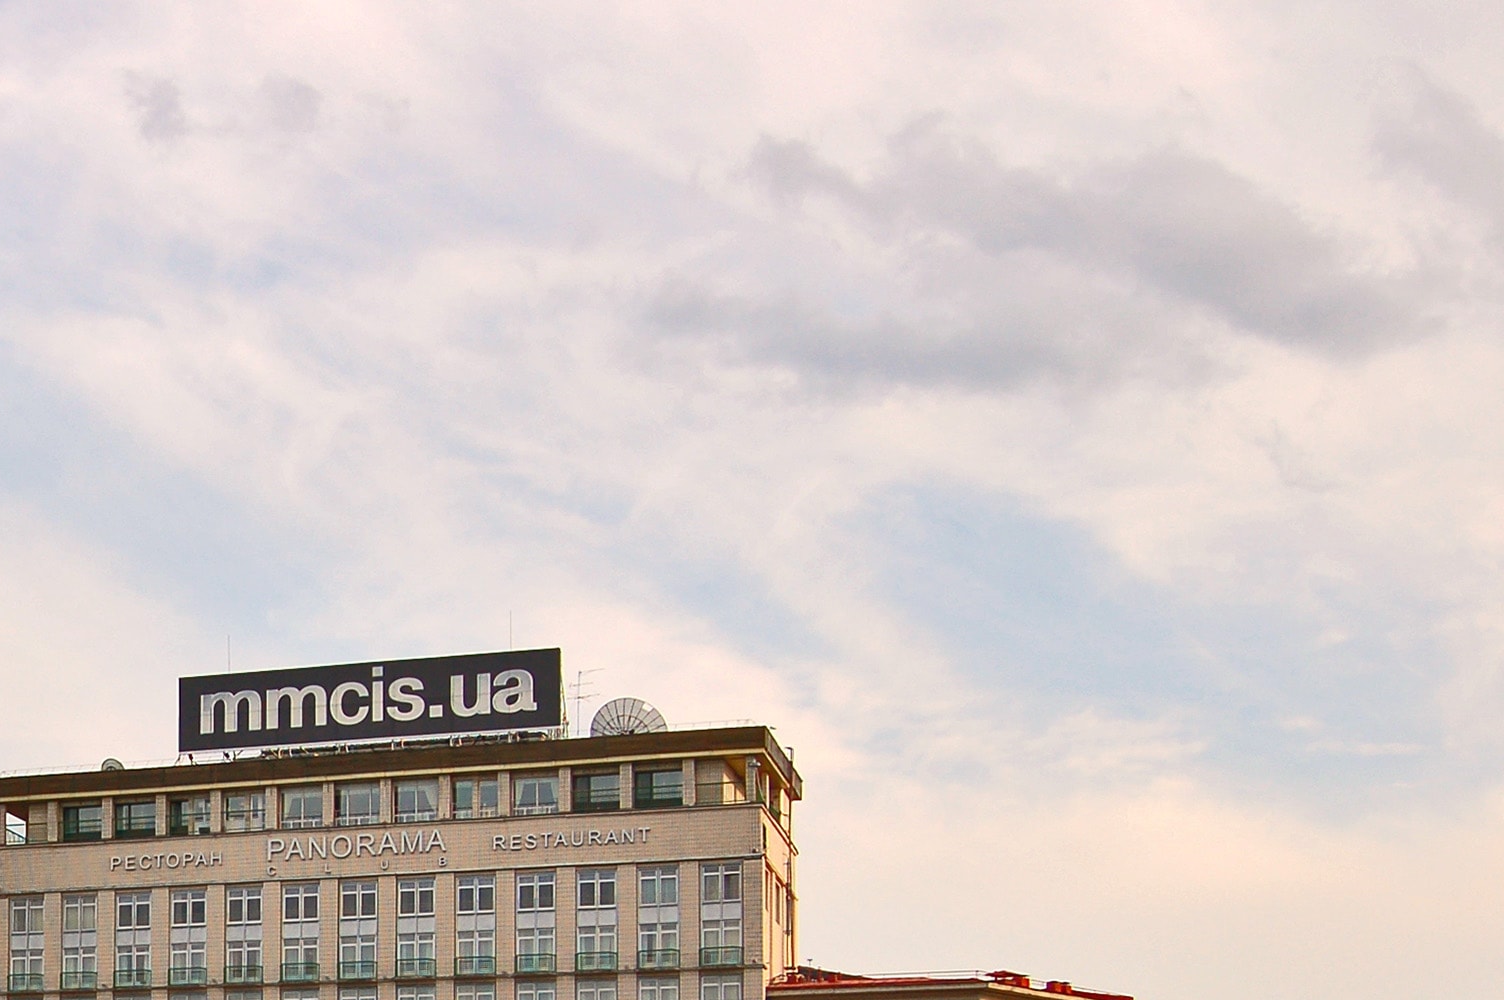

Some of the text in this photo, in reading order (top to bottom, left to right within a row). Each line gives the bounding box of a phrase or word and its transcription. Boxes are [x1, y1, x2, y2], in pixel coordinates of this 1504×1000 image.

[200, 666, 538, 735] mmcis.ua
[266, 829, 447, 861] PANORAMA
[493, 827, 651, 850] RESTAURANT
[110, 853, 223, 871] РЕСТОРАН
